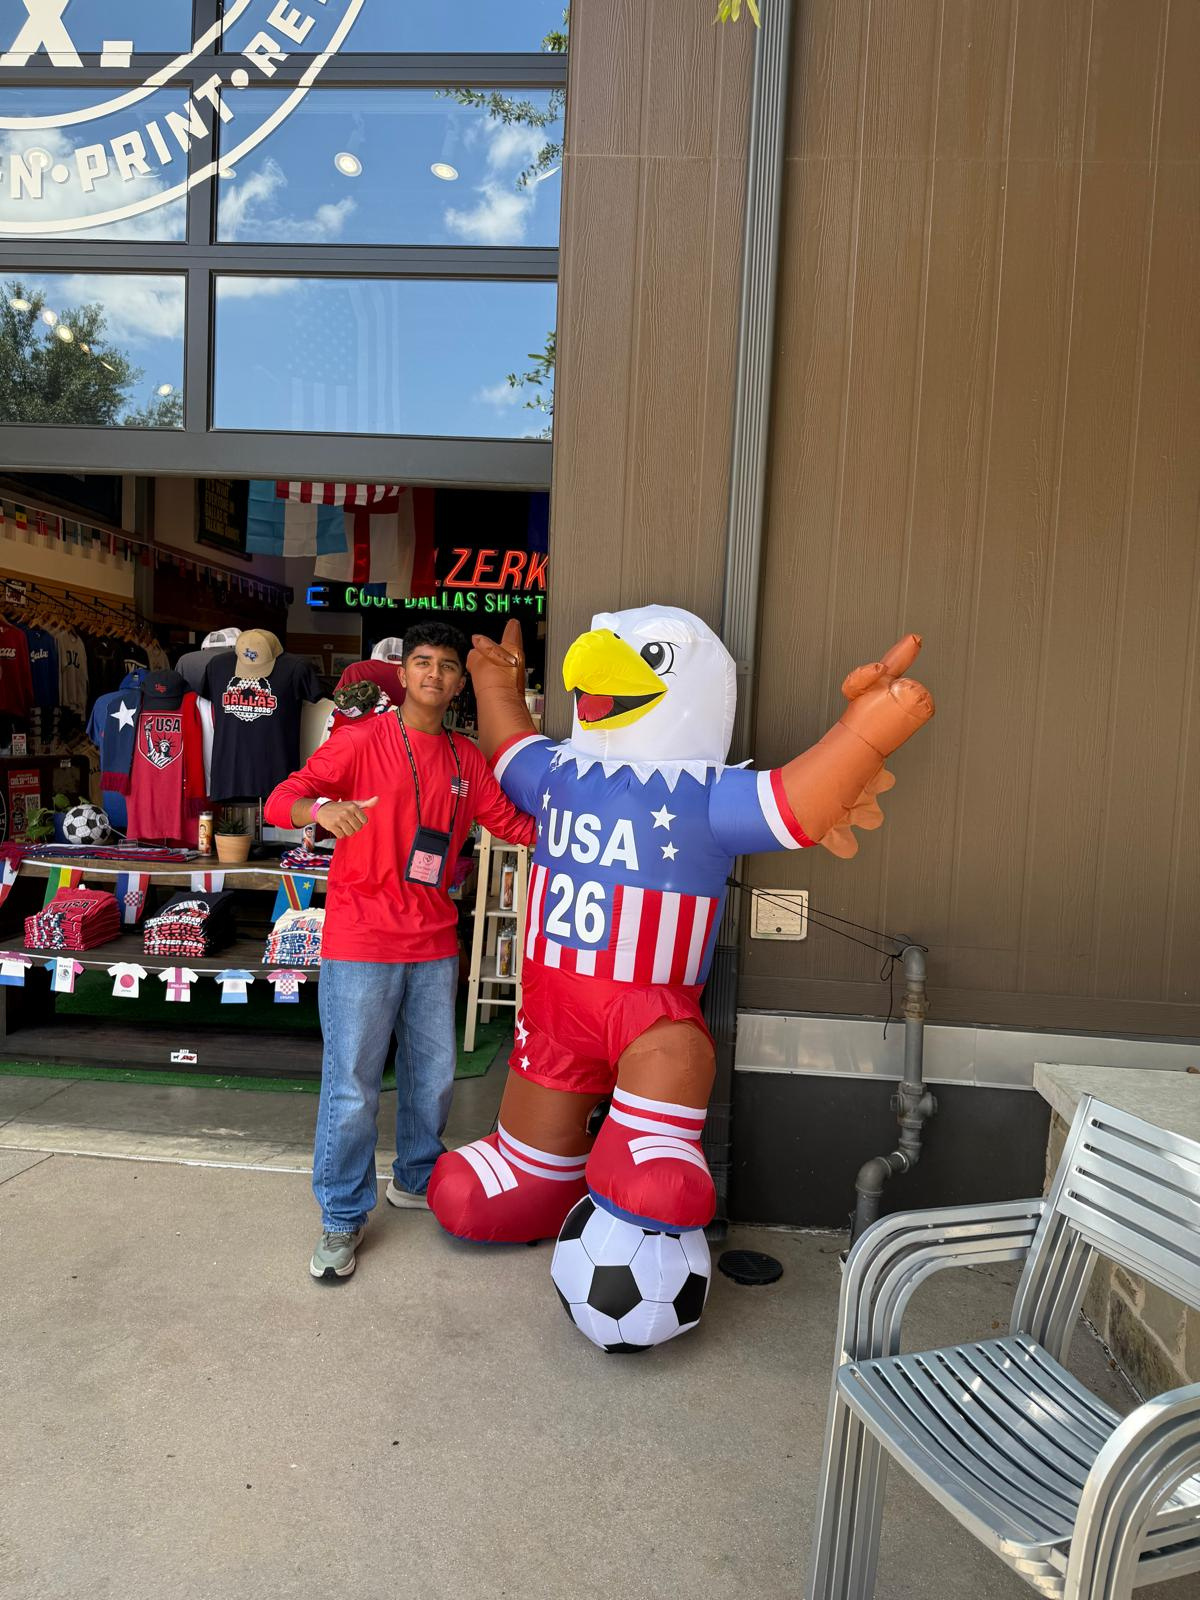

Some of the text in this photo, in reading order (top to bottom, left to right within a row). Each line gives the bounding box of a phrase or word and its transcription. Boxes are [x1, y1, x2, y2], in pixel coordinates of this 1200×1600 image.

[75, 73, 235, 192] PRINT
[241, 0, 326, 78] RE
[434, 547, 549, 591] ZERK
[223, 694, 276, 709] DALLAS
[225, 704, 253, 712] SOCCER
[156, 717, 182, 733] USA
[548, 807, 640, 871] USA
[545, 873, 606, 944] 26
